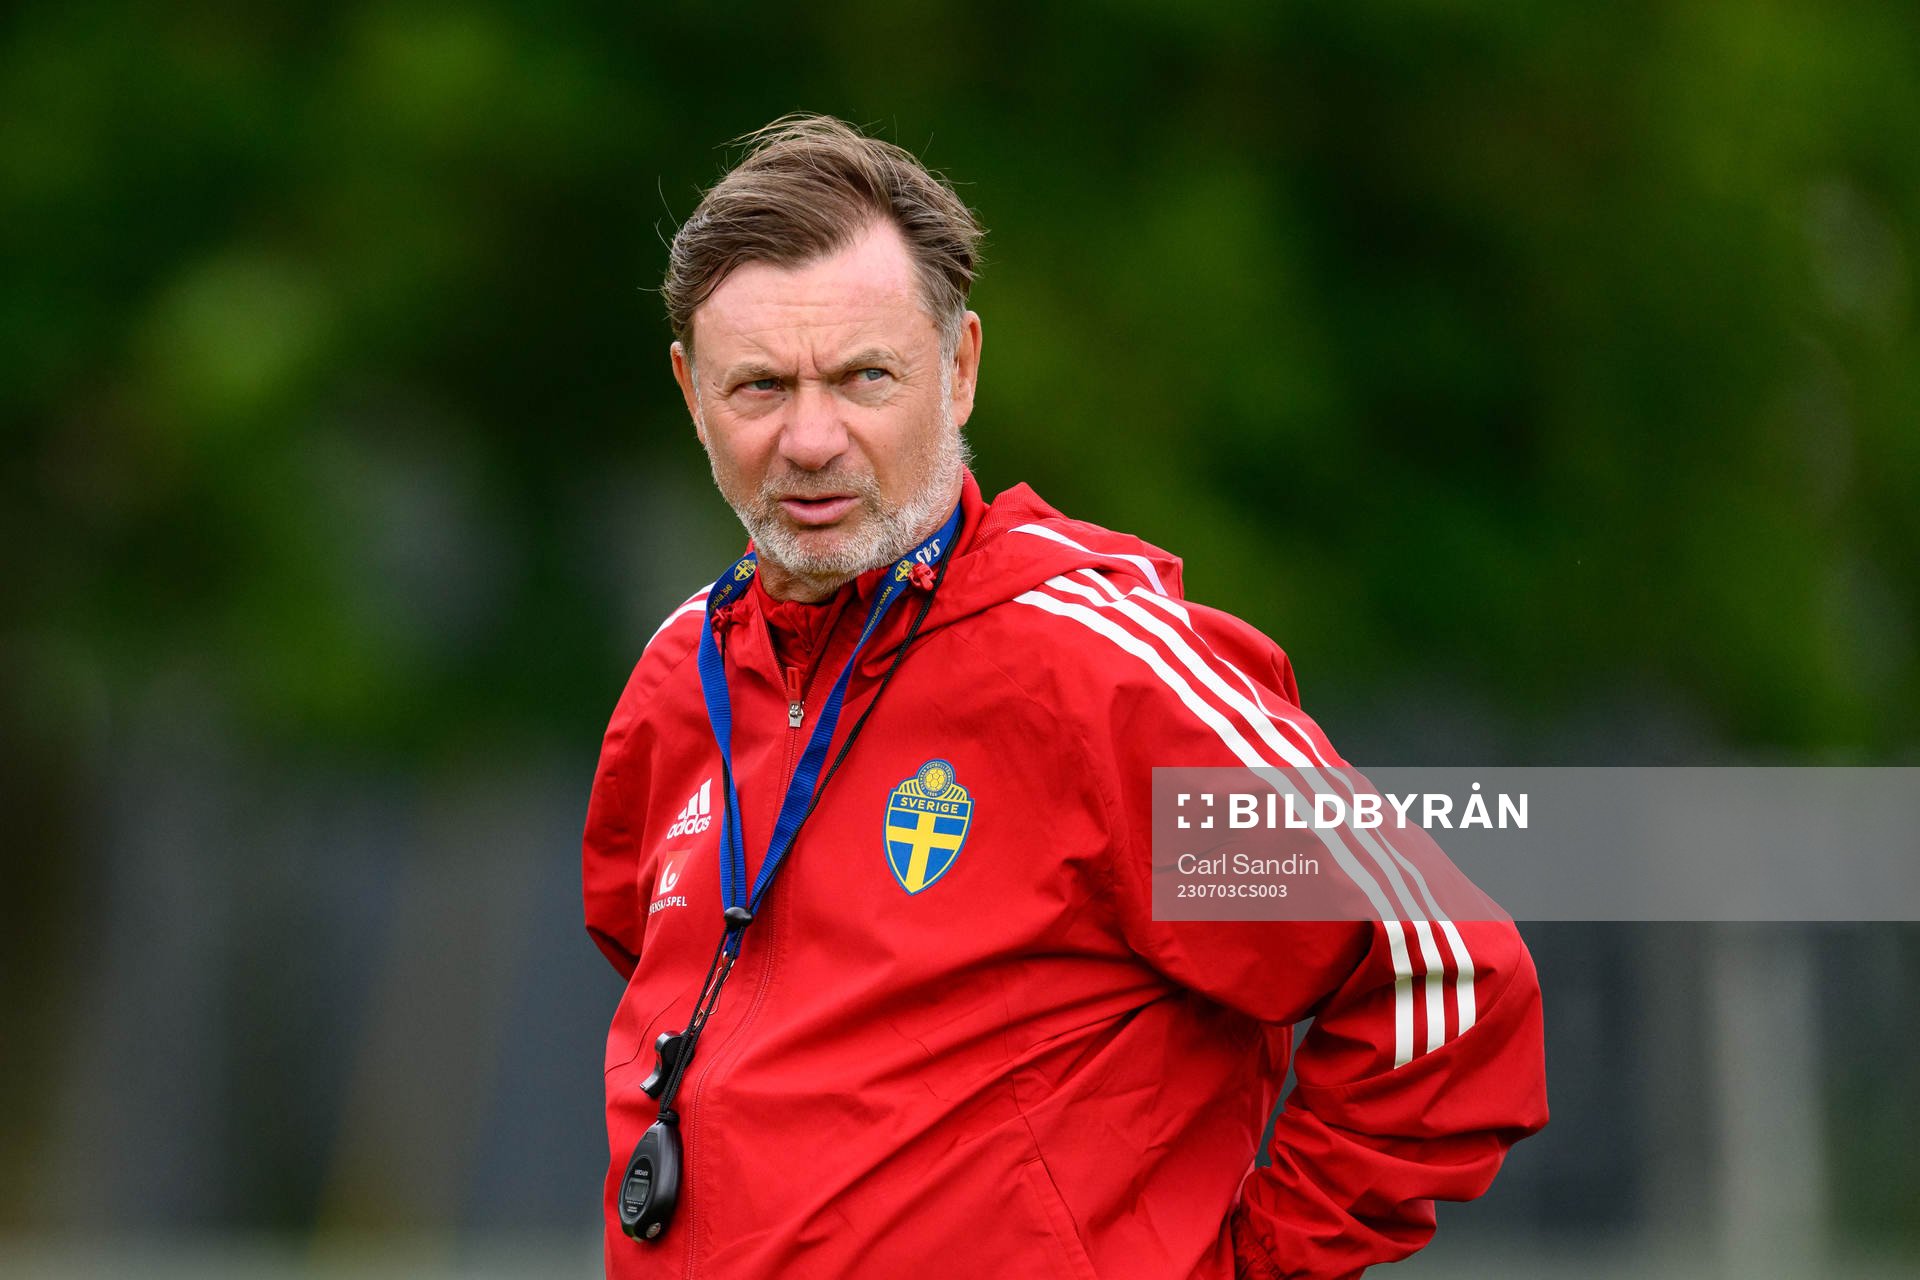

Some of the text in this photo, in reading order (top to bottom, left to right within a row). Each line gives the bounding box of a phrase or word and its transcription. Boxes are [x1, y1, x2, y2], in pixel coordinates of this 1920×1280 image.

[900, 797, 959, 814] SVERIGE
[666, 814, 711, 840] adidas
[666, 895, 688, 907] SPEL
